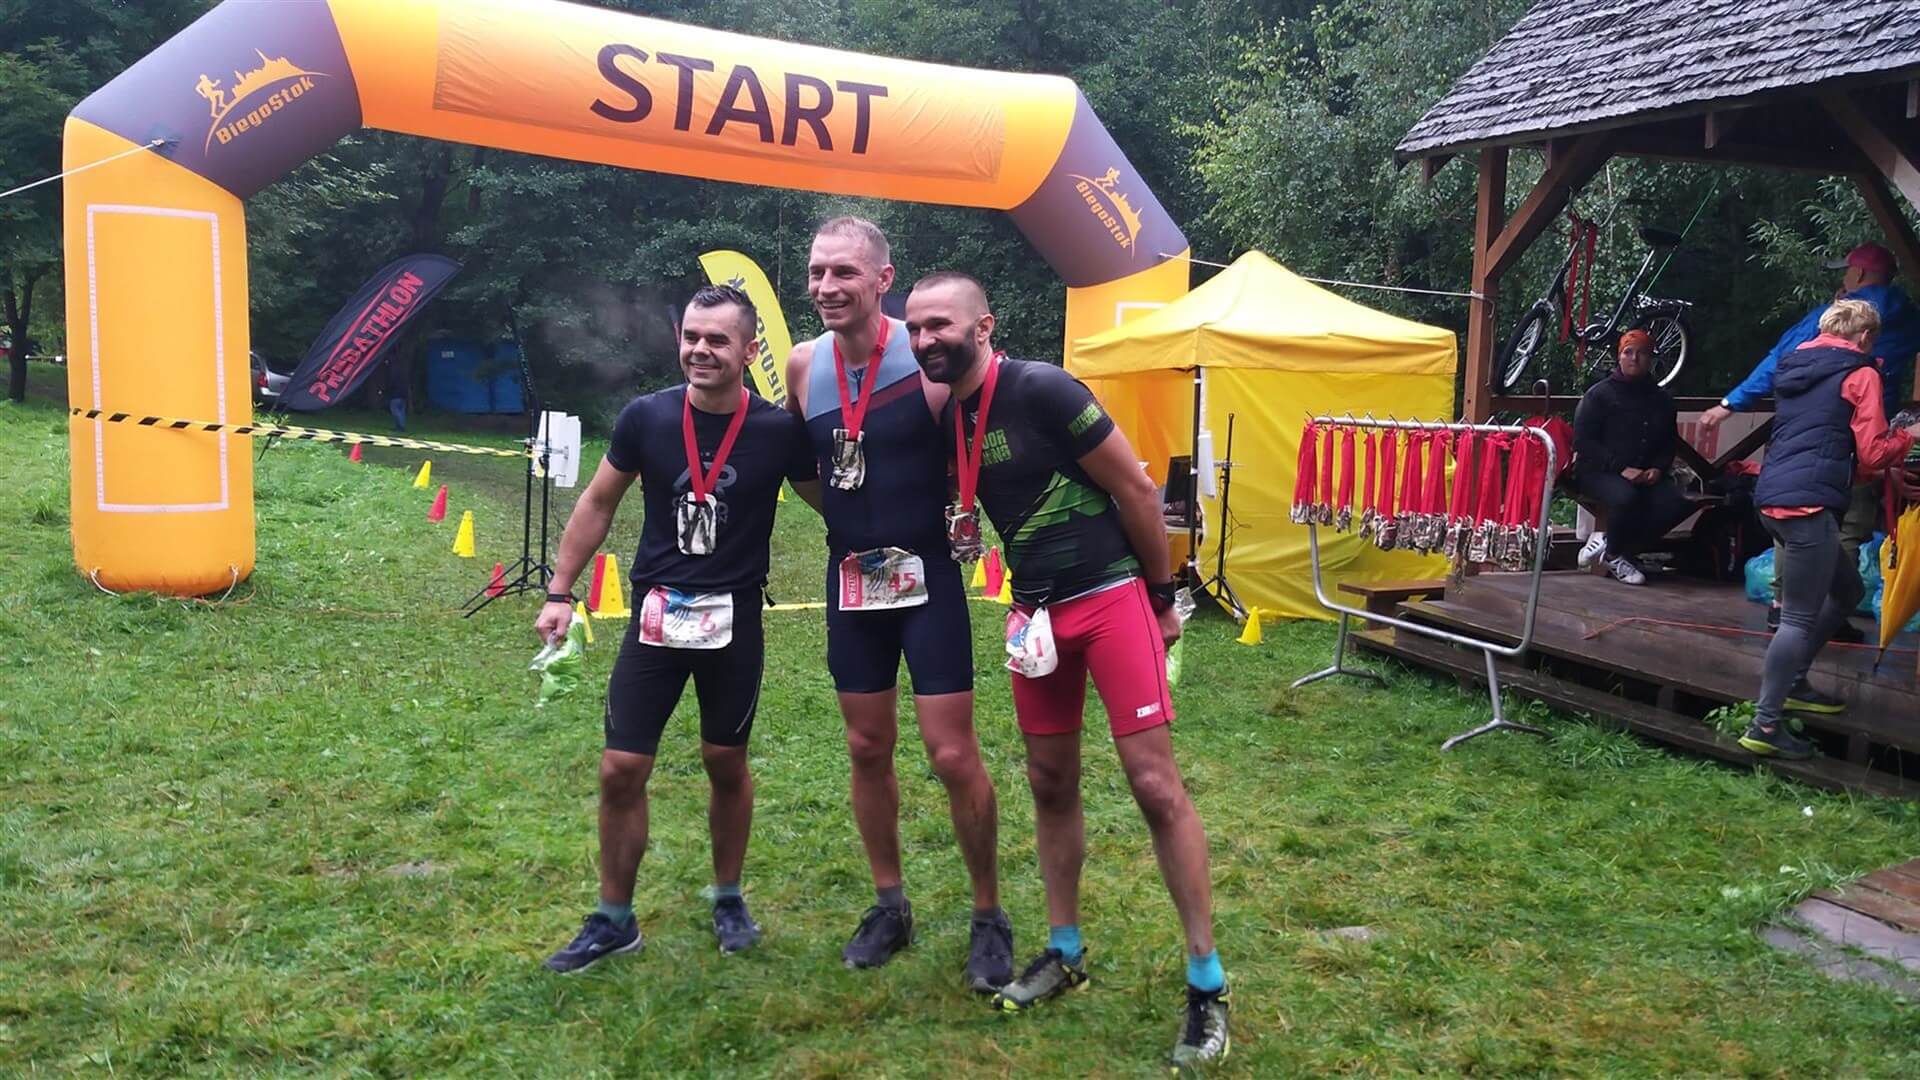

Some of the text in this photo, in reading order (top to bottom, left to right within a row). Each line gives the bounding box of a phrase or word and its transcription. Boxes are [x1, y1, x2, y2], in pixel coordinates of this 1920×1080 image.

[216, 76, 315, 144] BiegoStok
[590, 43, 888, 154] START
[1076, 181, 1130, 249] BiegoStok
[309, 271, 424, 403] PREDATHLON
[887, 571, 918, 592] 45
